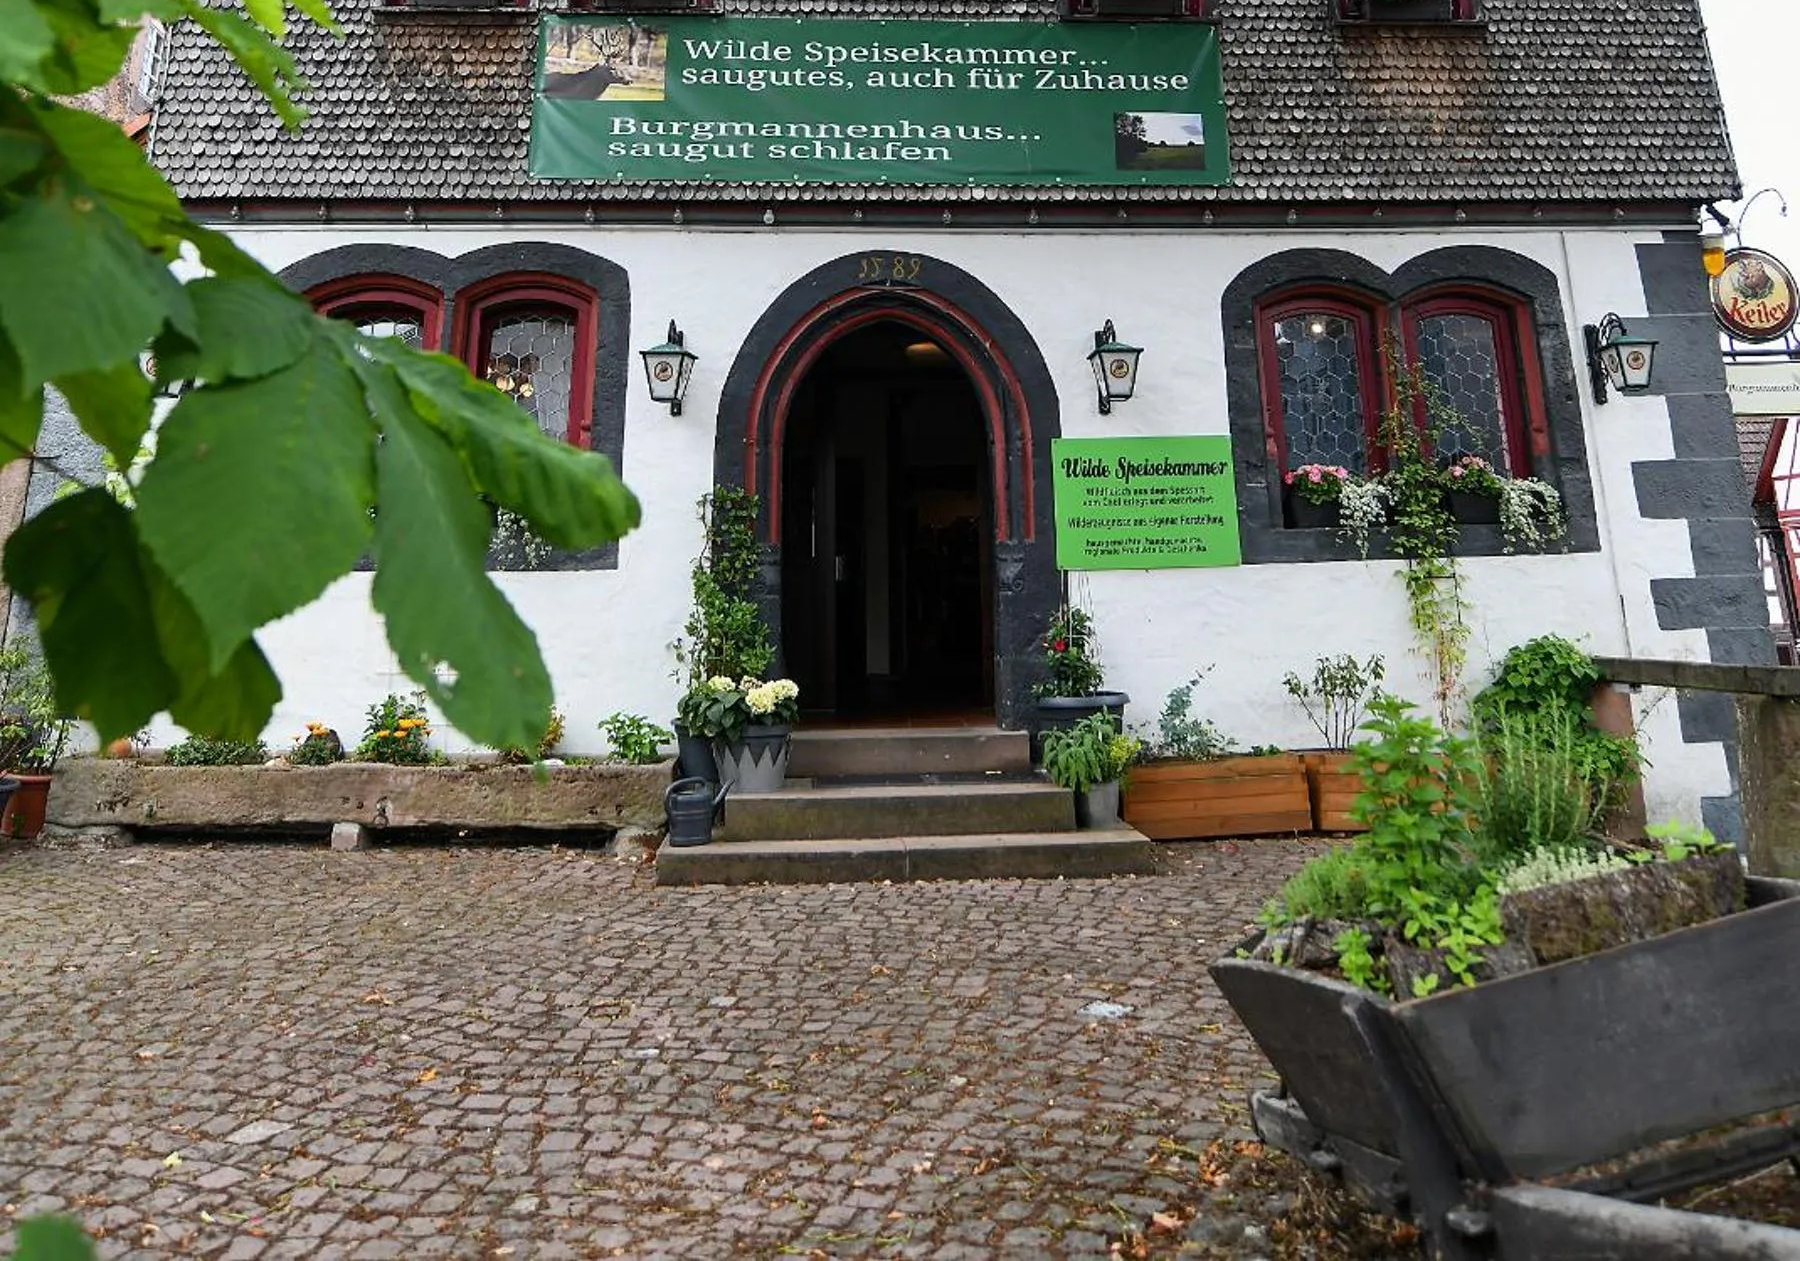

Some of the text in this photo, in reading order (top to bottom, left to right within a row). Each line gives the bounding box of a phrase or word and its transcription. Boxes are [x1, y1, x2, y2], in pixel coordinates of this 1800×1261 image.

[683, 39, 1108, 68] Wilde Speisekammer...
[682, 64, 1189, 90] saugutes, auch für Zuhause
[608, 116, 1041, 141] Burgmannenhaus...
[608, 140, 952, 163] saugut schlafen
[1728, 296, 1786, 325] Keiler
[1061, 457, 1227, 484] Wilde Speisekammer
